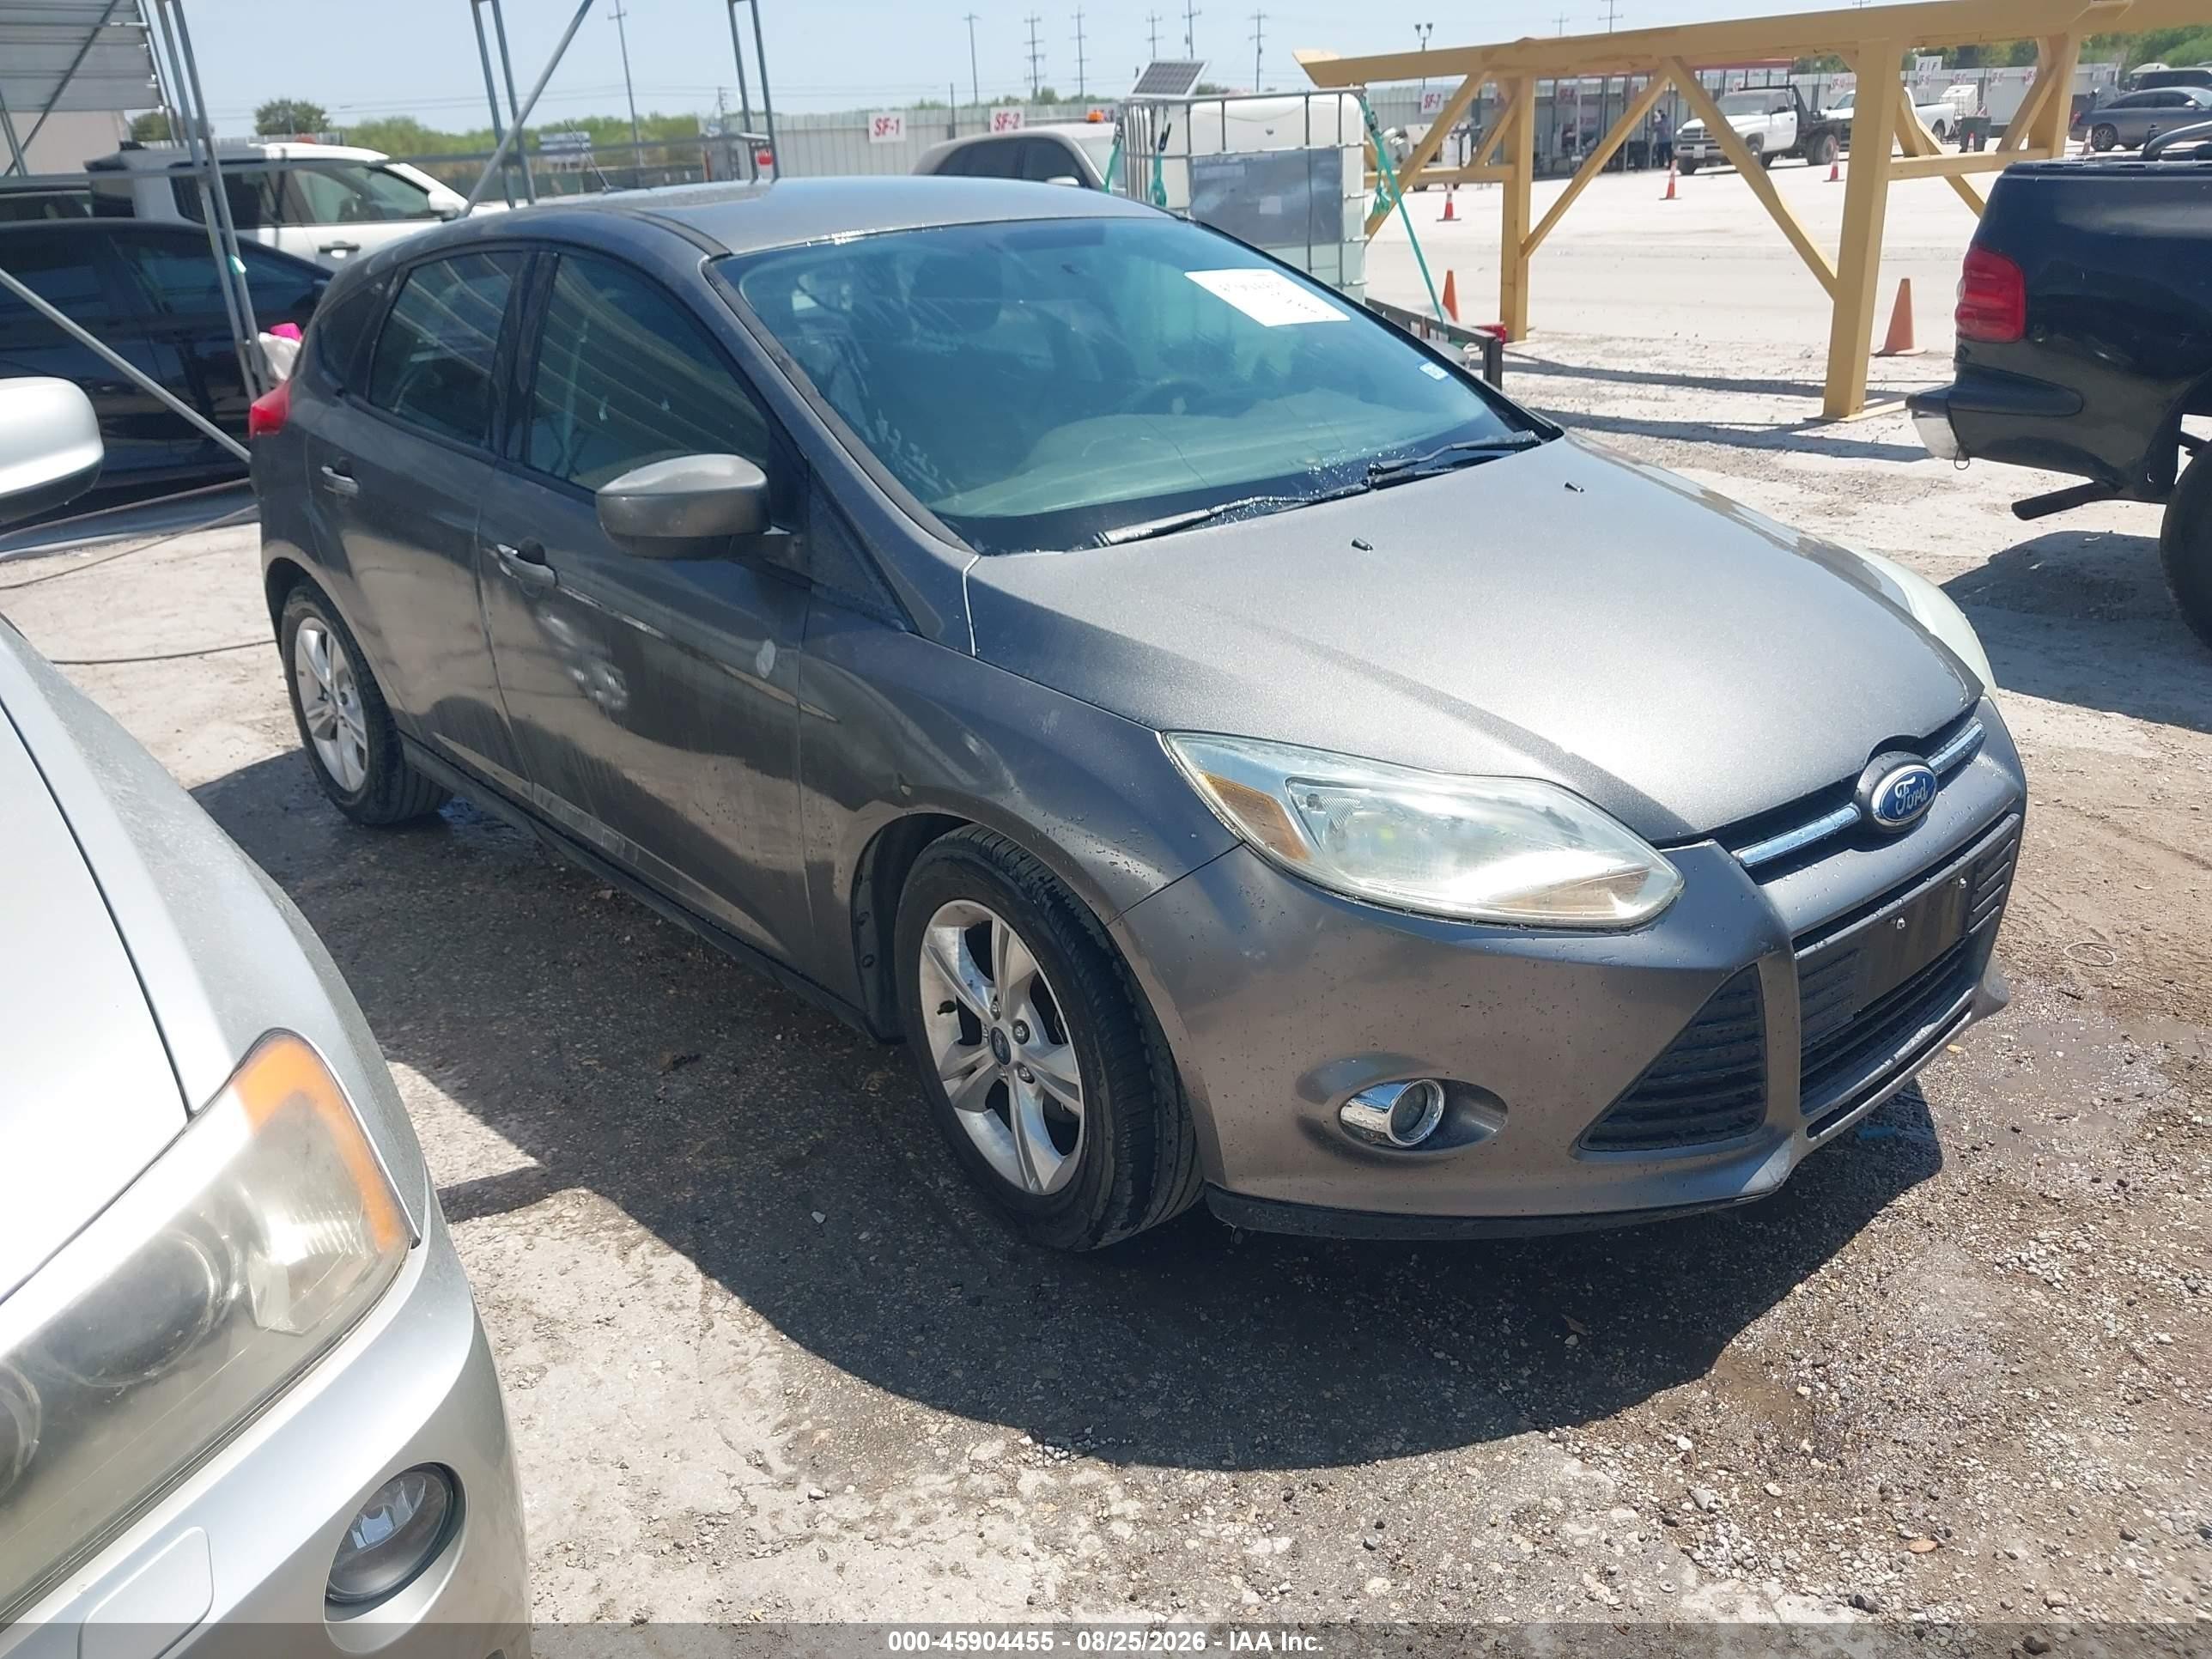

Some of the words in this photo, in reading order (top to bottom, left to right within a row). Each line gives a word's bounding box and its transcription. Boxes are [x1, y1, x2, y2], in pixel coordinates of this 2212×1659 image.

[874, 117, 900, 137] SF-1
[994, 112, 1021, 131] SF-2
[1894, 775, 1929, 816] Ford
